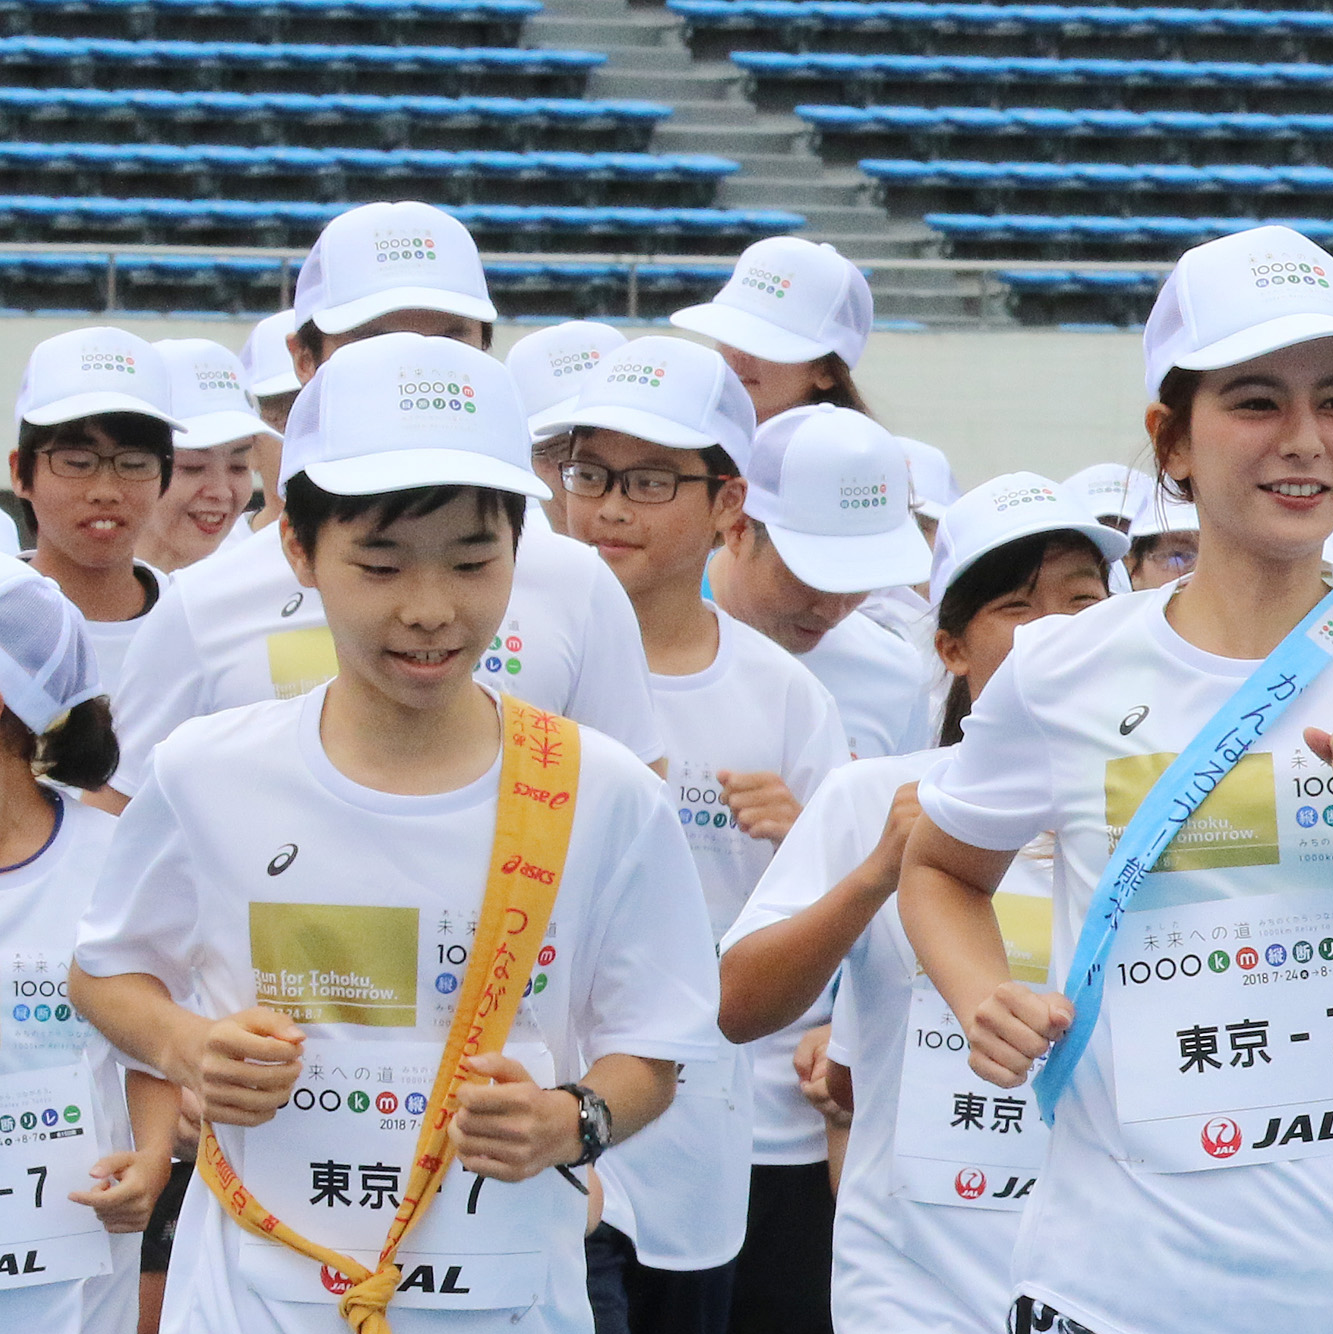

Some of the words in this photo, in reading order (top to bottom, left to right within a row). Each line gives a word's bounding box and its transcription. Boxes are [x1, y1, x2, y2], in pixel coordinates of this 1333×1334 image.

[1144, 923, 1251, 951] 未来への道
[1242, 972, 1269, 986] 2018
[1176, 1019, 1272, 1073] 東京
[380, 1119, 406, 1130] 2018
[950, 1092, 1027, 1134] 東京
[310, 1160, 401, 1209] 東京
[394, 1264, 470, 1294] AL
